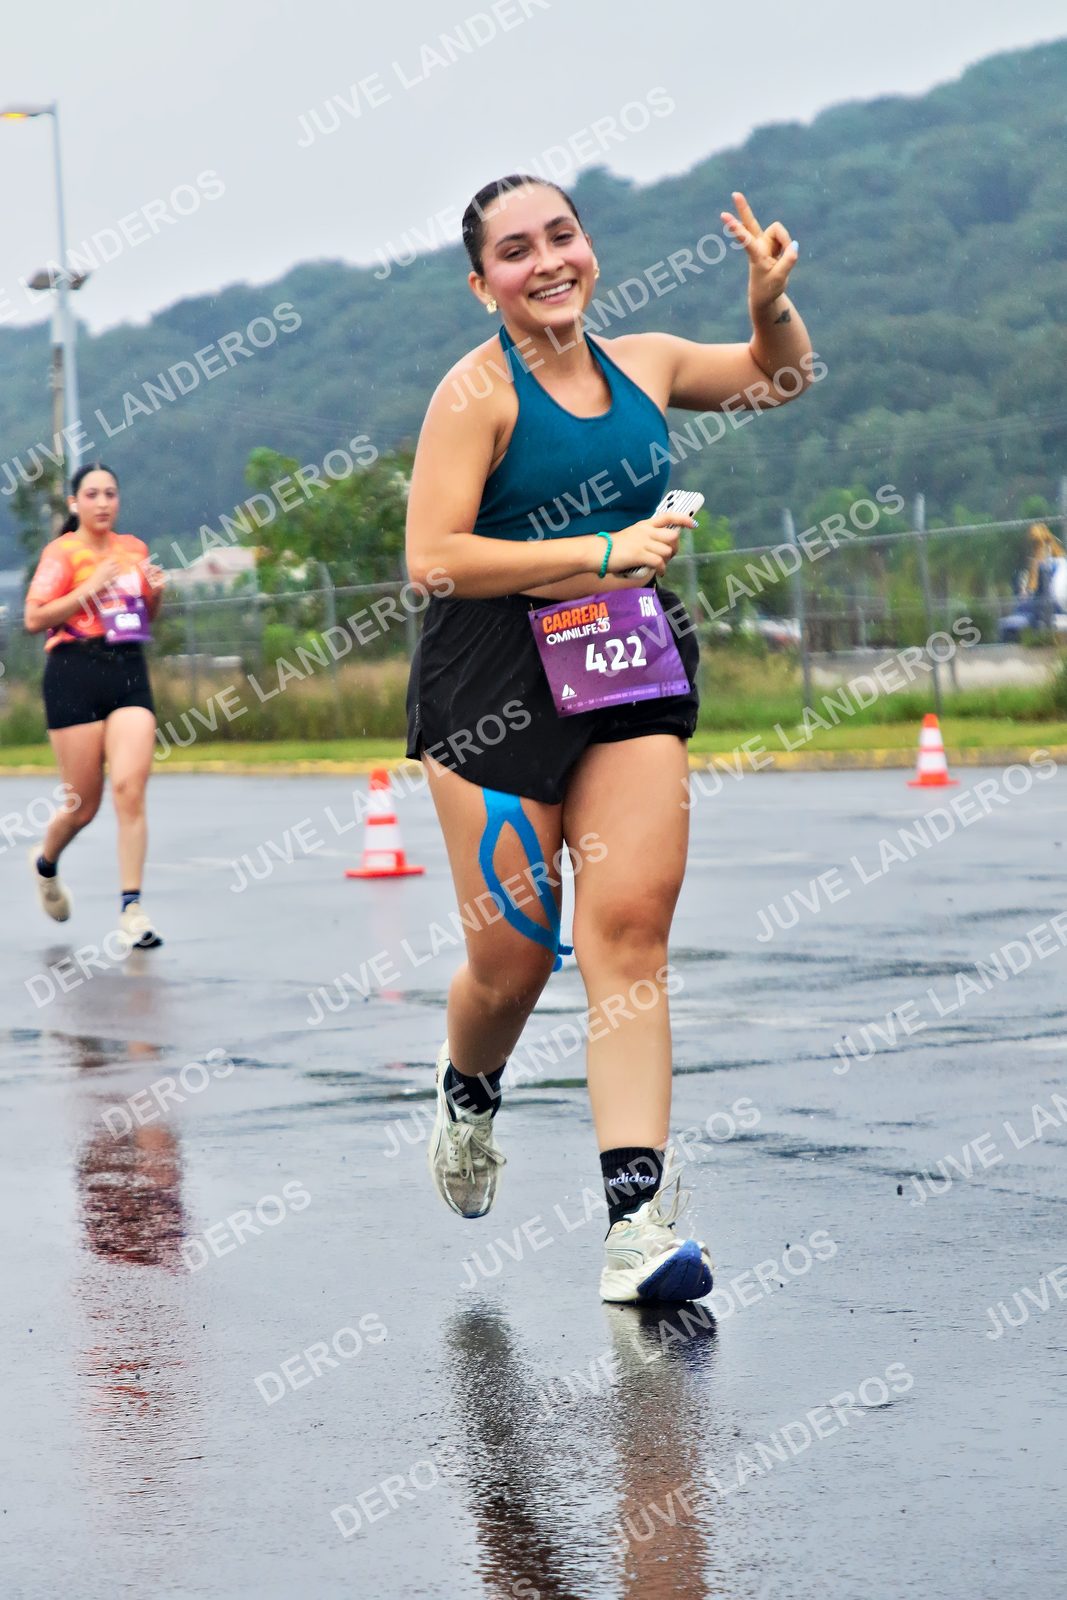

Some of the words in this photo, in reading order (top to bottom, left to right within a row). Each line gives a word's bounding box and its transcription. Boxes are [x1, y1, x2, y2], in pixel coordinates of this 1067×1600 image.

[542, 602, 609, 634] CARRERA
[546, 622, 598, 645] OMNILIFE
[585, 635, 647, 673] 422
[609, 1172, 657, 1186] adidas
